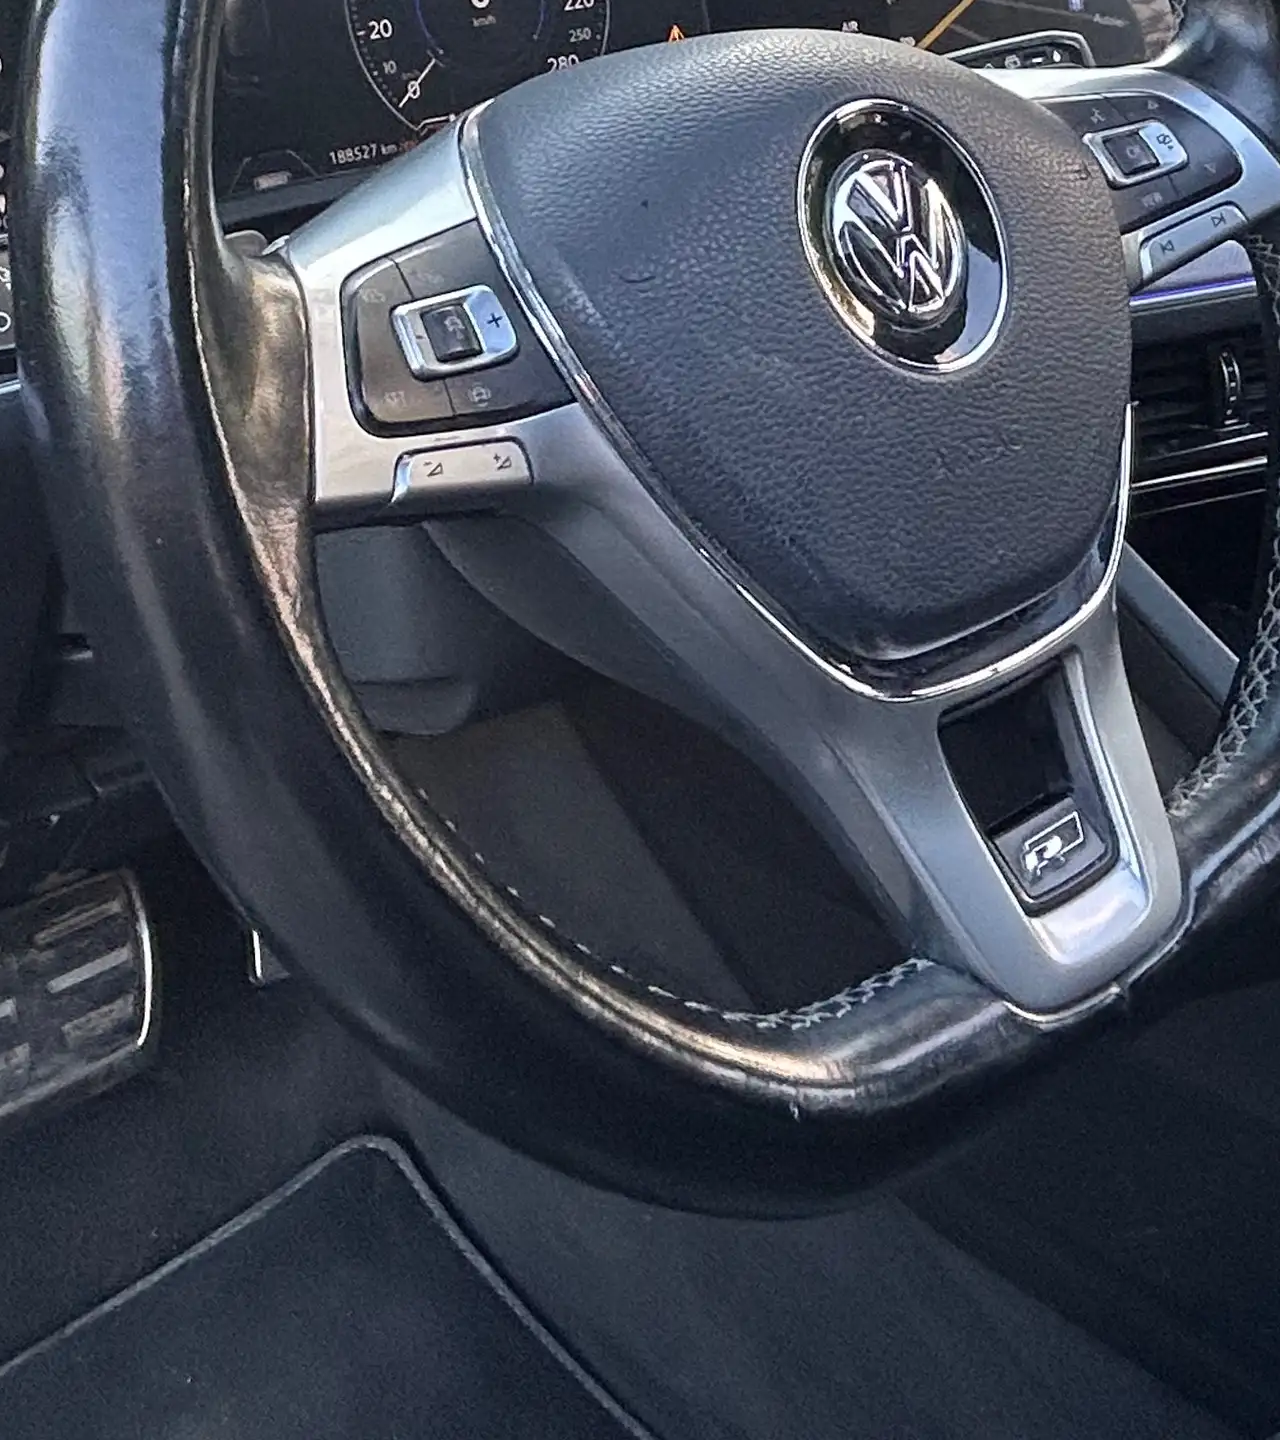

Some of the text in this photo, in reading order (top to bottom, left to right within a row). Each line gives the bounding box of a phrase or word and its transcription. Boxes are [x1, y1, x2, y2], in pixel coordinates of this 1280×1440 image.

[368, 19, 393, 40] 20
[569, 27, 592, 43] 250
[383, 60, 397, 74] 10
[329, 143, 377, 165] 188527
